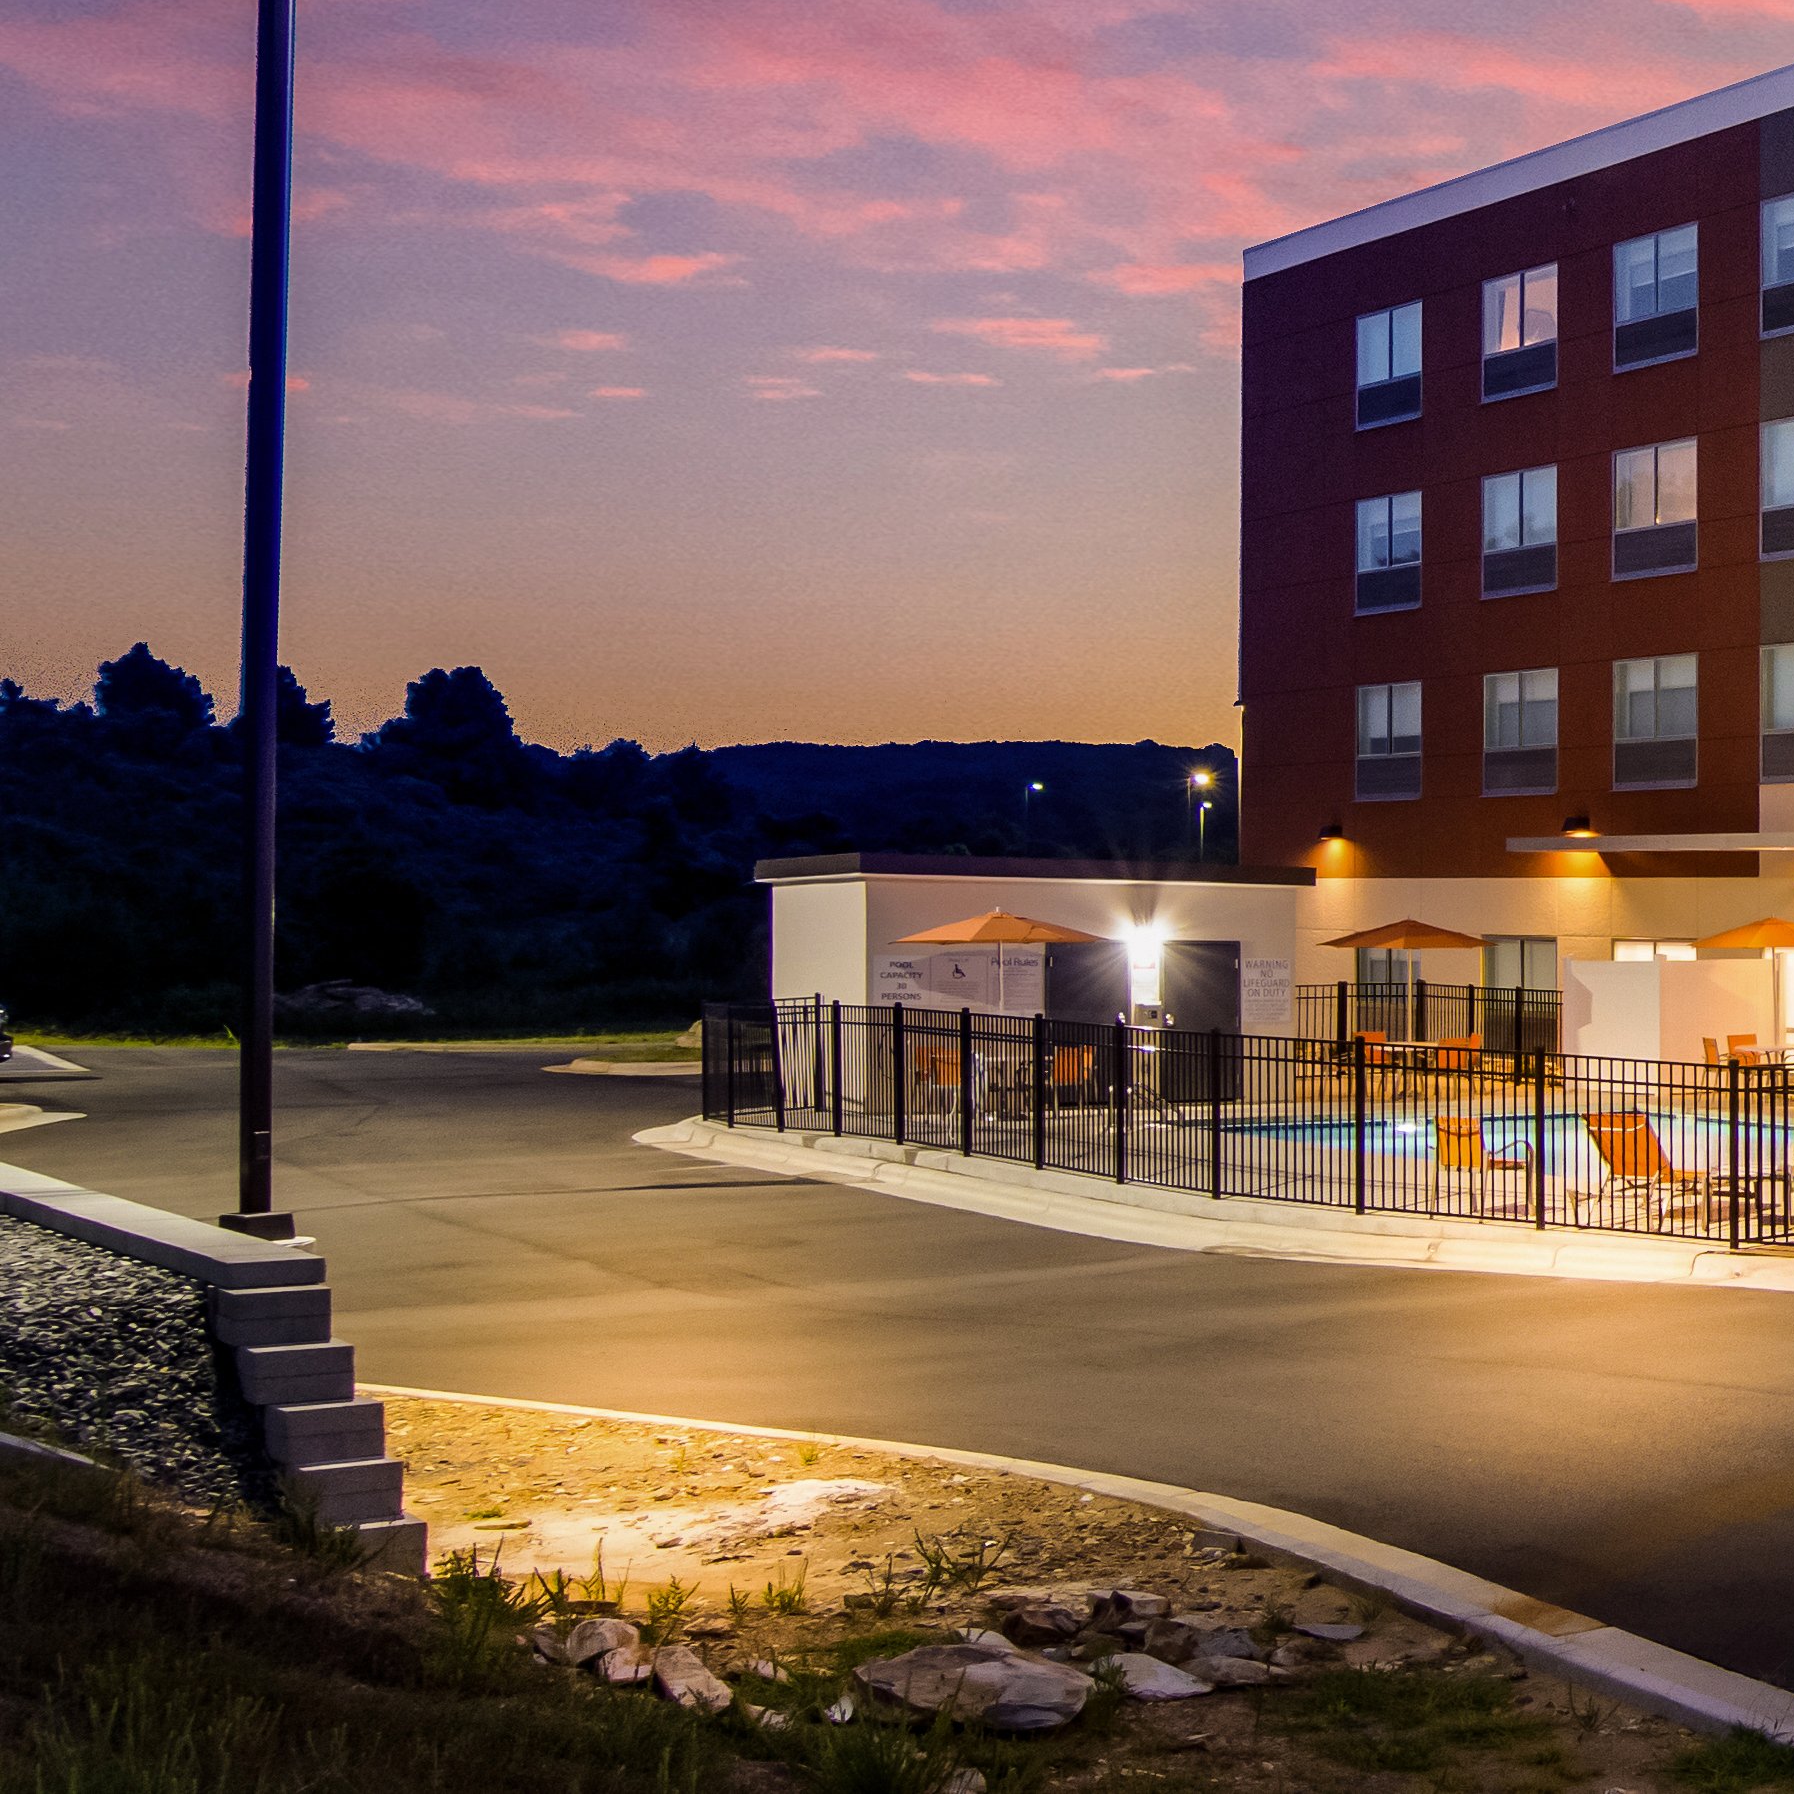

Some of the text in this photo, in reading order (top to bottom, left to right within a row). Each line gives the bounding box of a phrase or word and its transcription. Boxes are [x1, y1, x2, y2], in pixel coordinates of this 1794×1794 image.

[890, 961, 913, 969] POOL
[991, 957, 1039, 967] Pol Rules
[1245, 960, 1289, 969] WARNING
[1260, 969, 1273, 978] NO
[1243, 979, 1290, 988] LIFEGUARD
[881, 992, 922, 1001] PERSONS
[1247, 988, 1286, 997] ON DUTY
